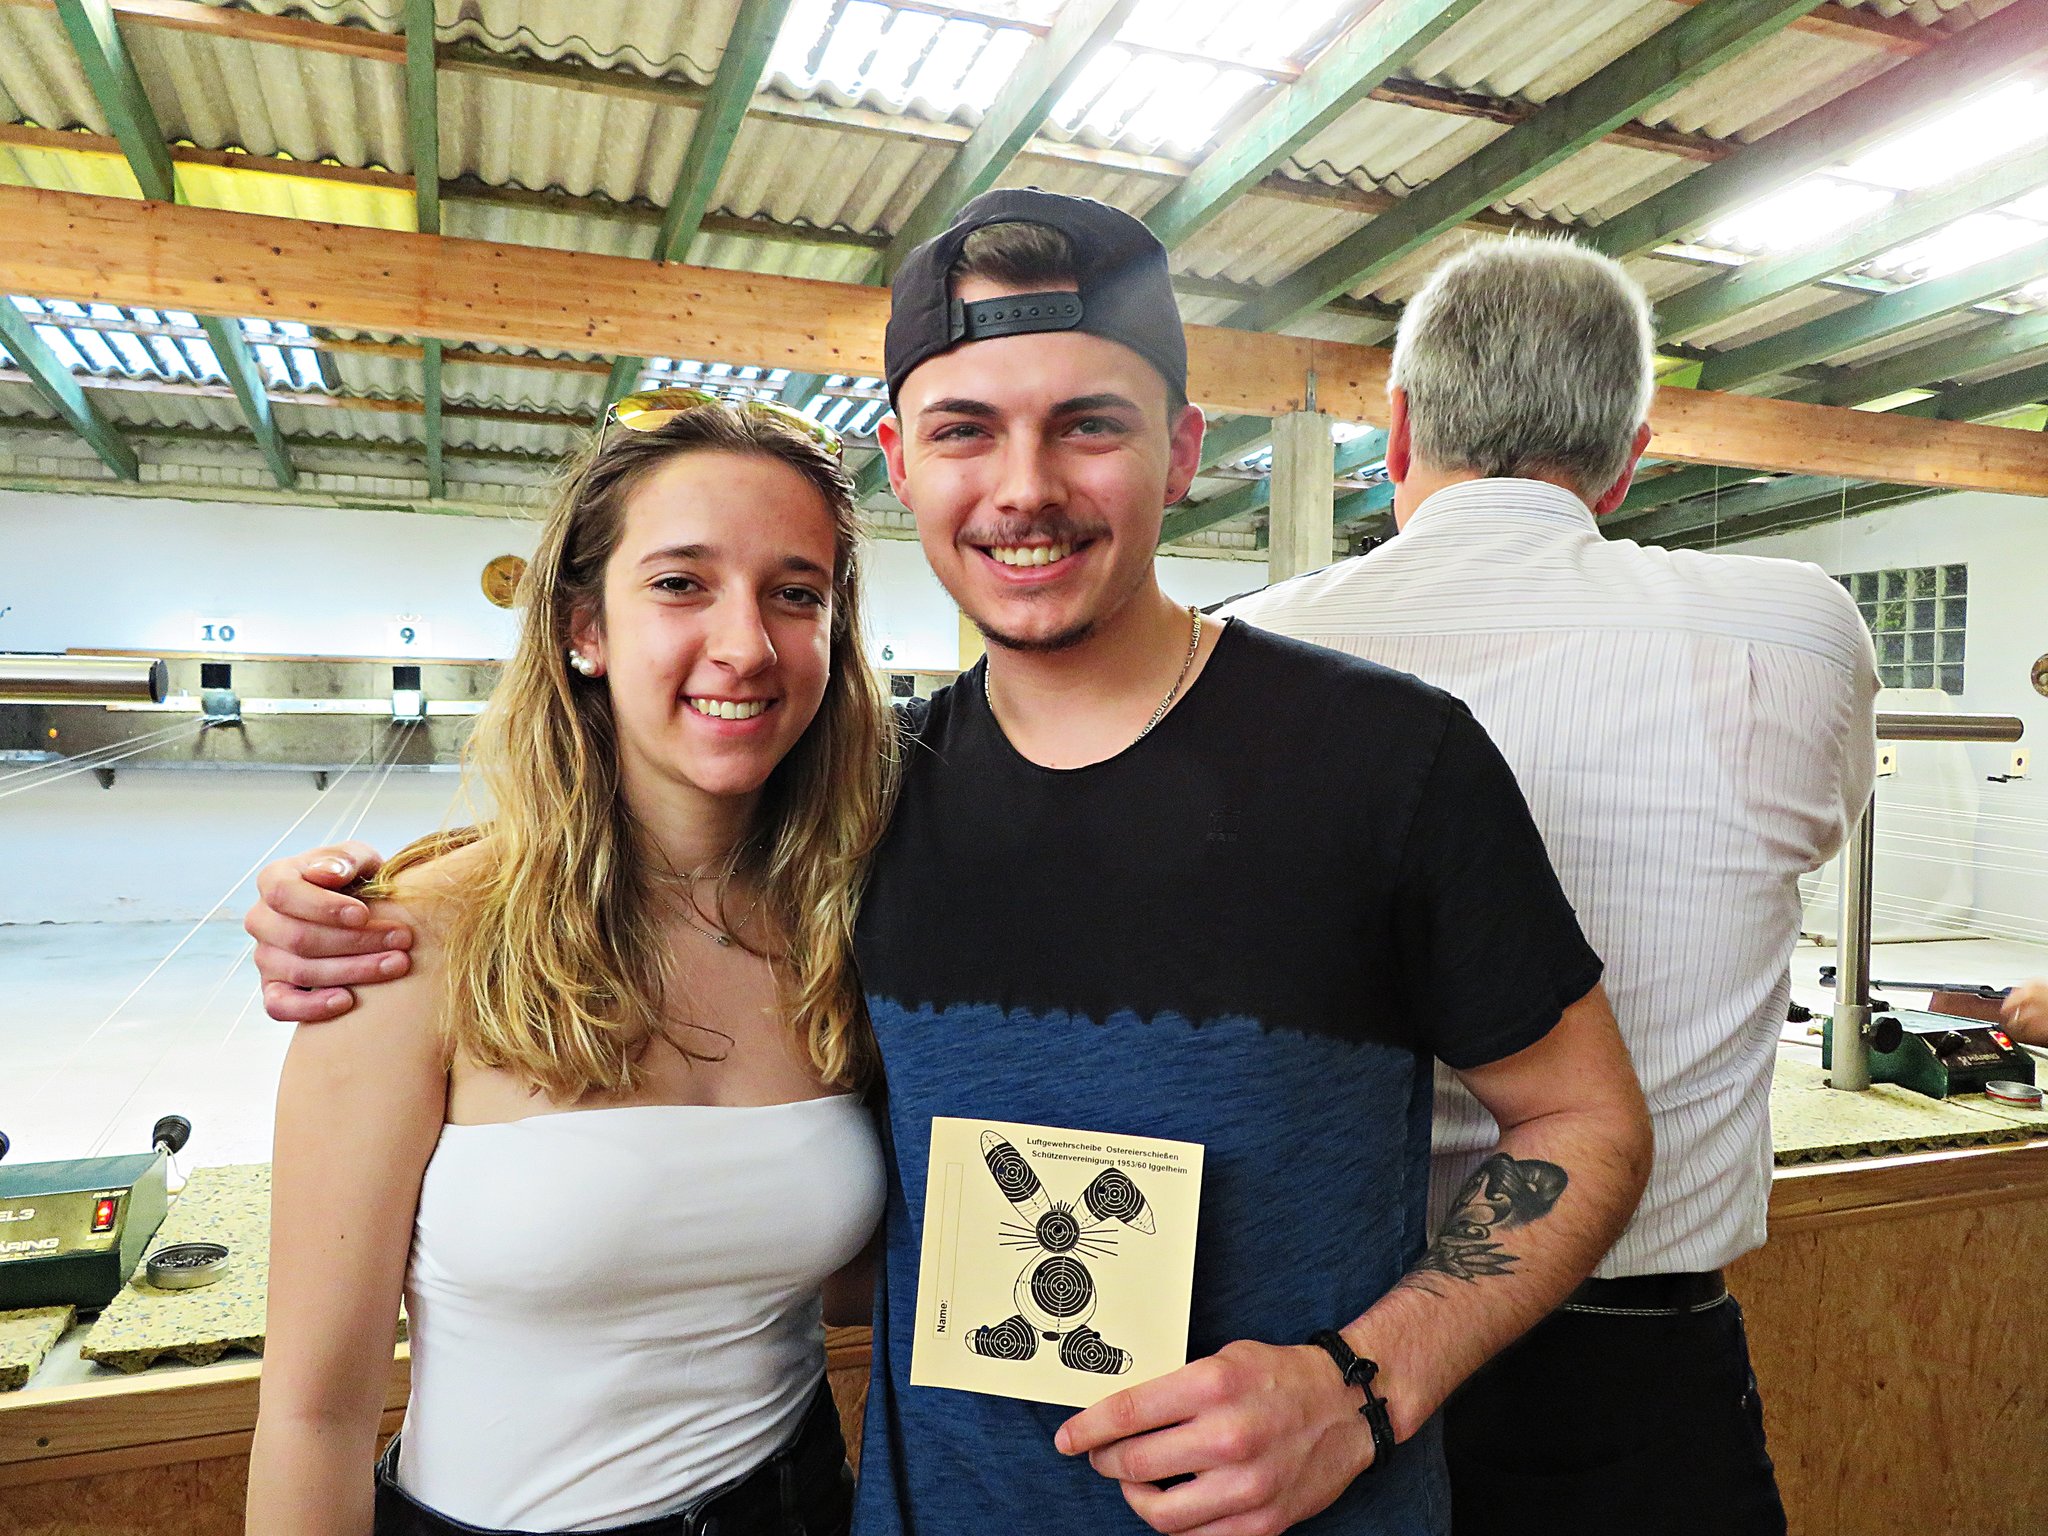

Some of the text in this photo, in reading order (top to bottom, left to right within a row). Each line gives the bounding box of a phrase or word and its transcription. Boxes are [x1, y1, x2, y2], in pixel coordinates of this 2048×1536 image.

[201, 624, 236, 642] 10
[400, 627, 416, 644] 9
[881, 645, 894, 661] 6
[1026, 1137, 1179, 1160] Luftgewehrscheibe Ostereierschießen
[1031, 1150, 1188, 1175] Schützenvereinigung 1953/60 Iggelheim
[937, 1299, 948, 1333] Name:
